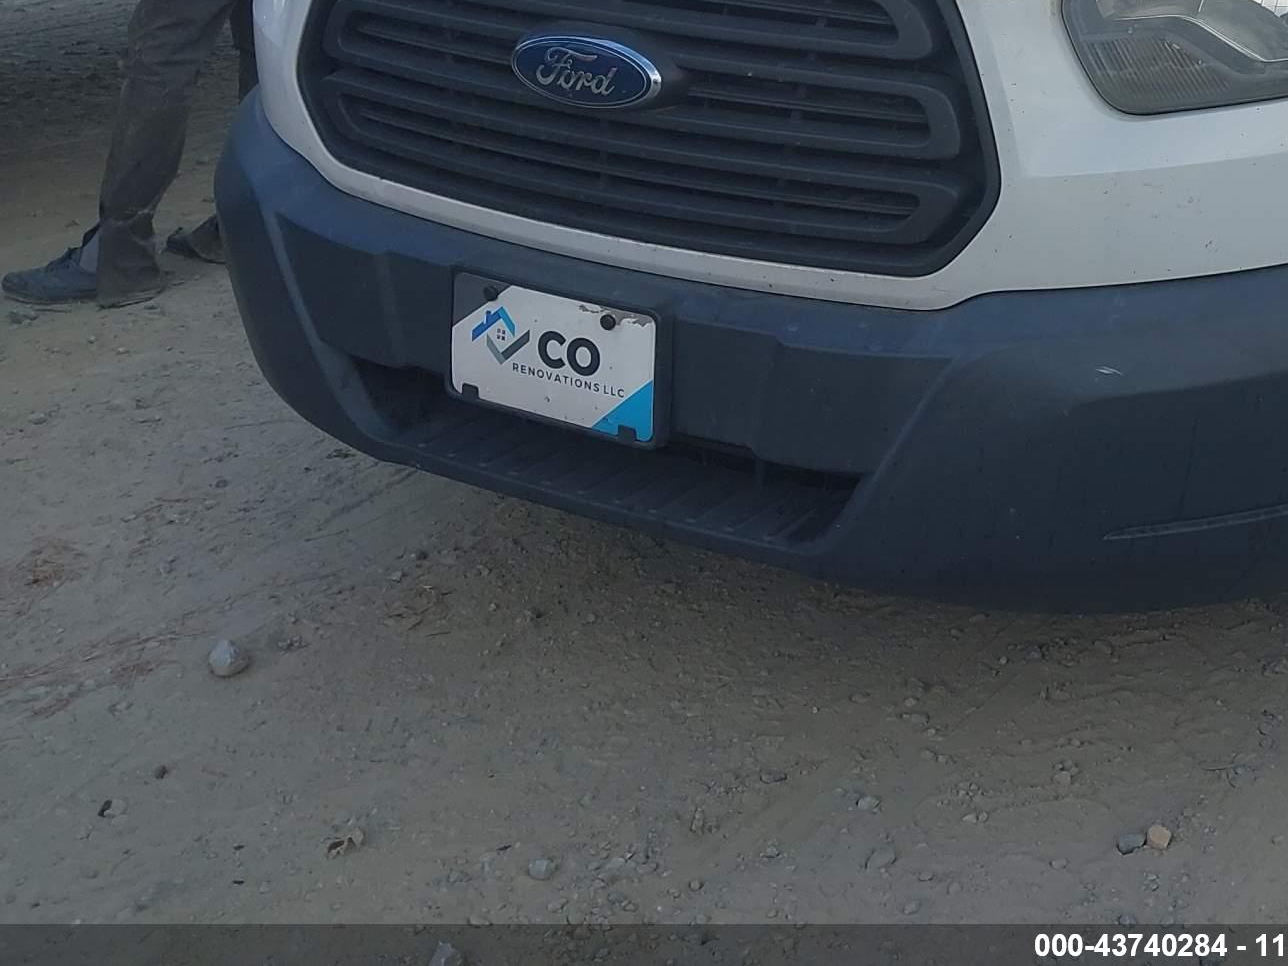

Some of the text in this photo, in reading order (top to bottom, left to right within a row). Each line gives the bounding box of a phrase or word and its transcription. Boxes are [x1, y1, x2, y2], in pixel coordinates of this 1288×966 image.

[535, 46, 618, 97] Ford
[537, 330, 601, 376] CO
[512, 362, 625, 398] RENOVATIONS LLC
